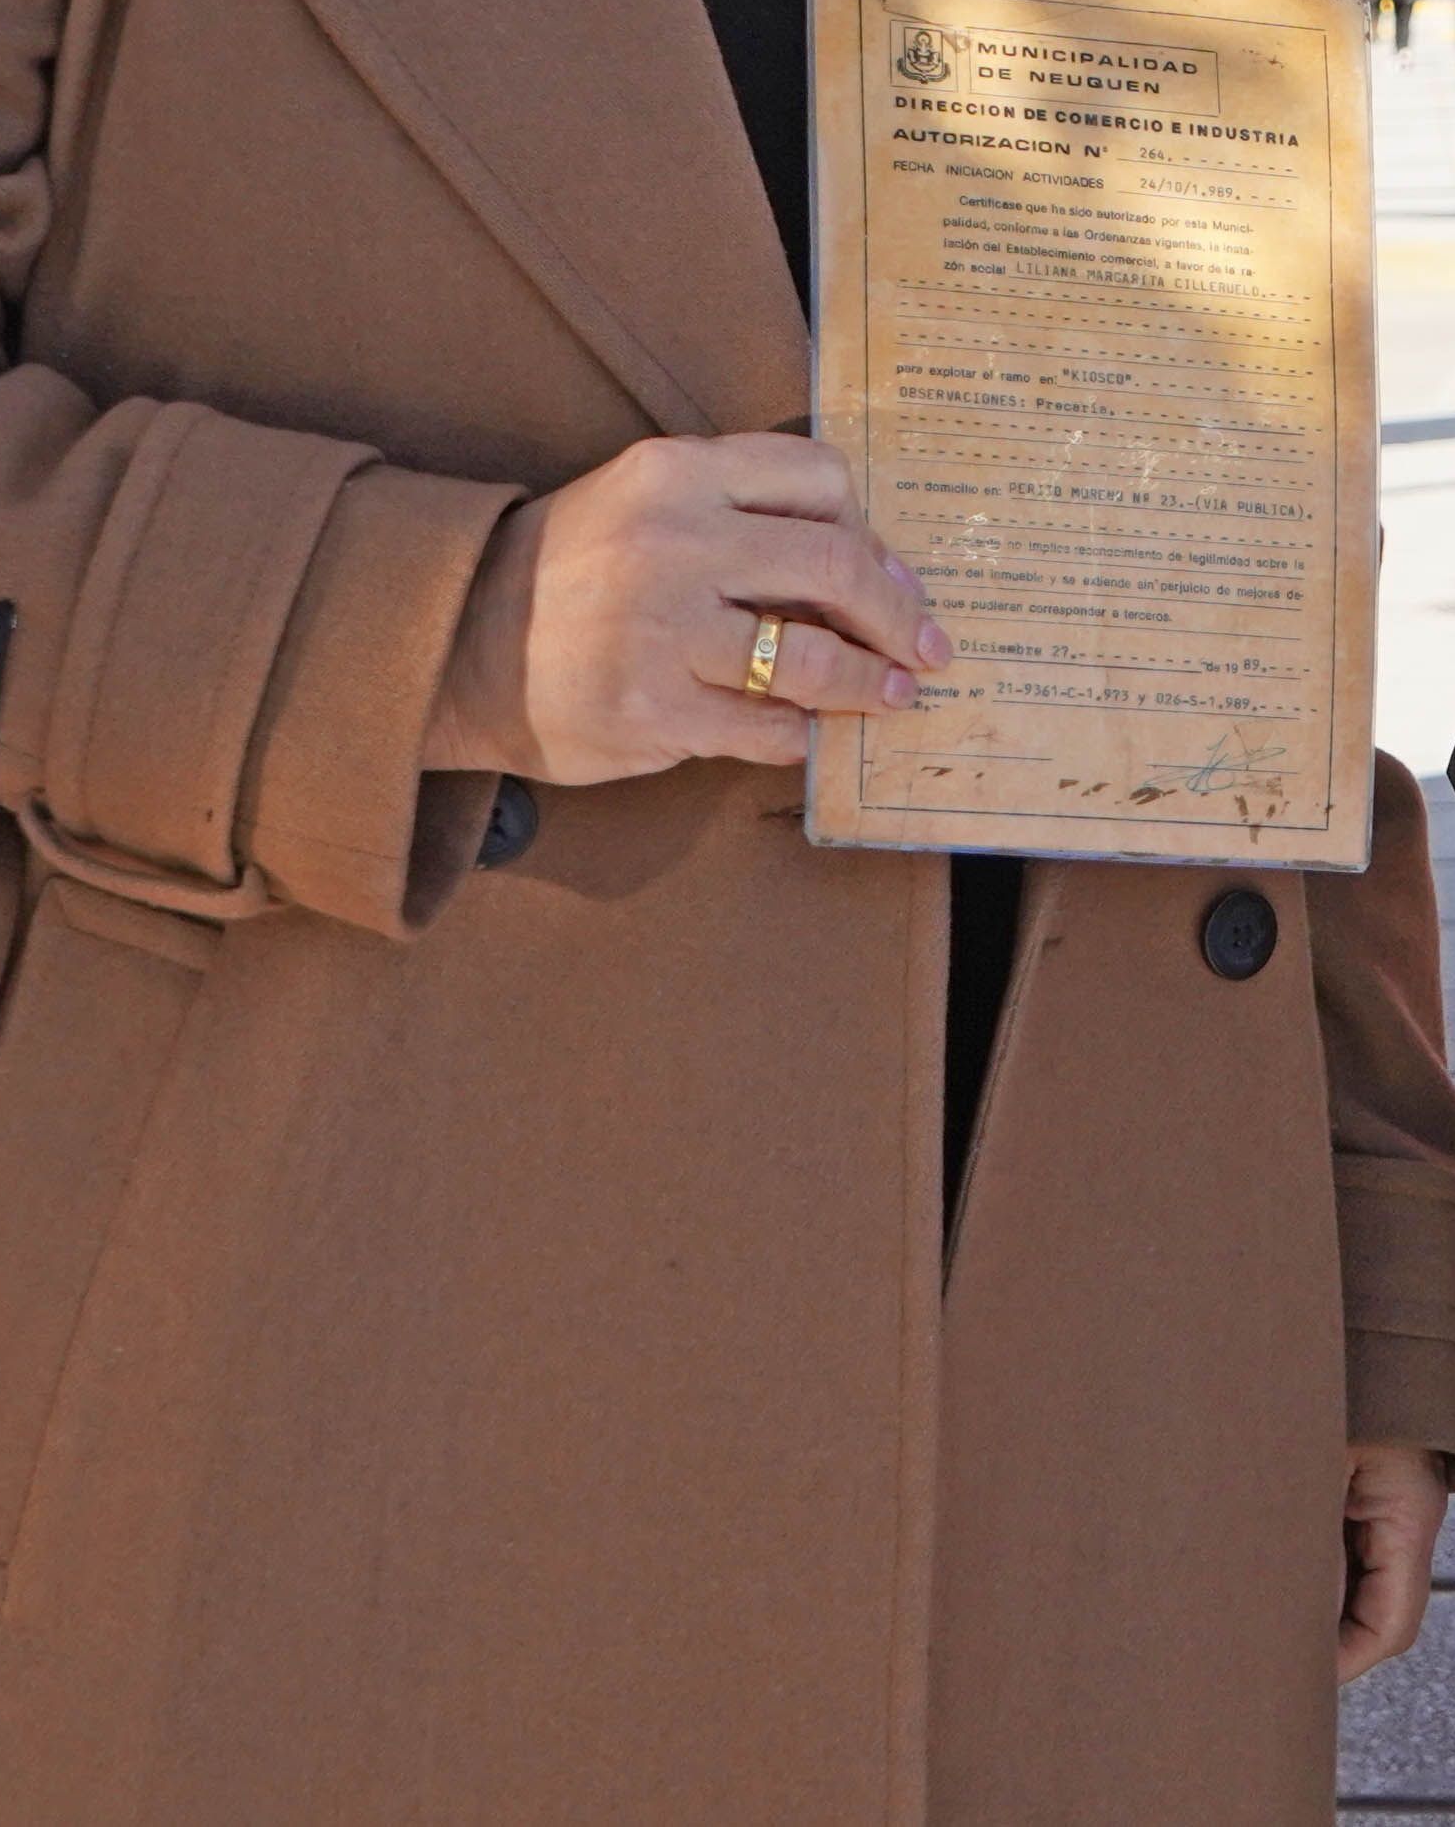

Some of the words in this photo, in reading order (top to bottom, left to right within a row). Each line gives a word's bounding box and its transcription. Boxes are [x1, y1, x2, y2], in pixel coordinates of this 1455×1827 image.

[978, 41, 1199, 75] MUNICIPALIDAD
[978, 66, 1013, 81] DE
[1029, 71, 1161, 94] NEUQUEN
[895, 96, 1016, 119] DIRECCION
[1024, 108, 1048, 122] DE
[1055, 110, 1164, 133] COMERCIO
[1171, 122, 1183, 134] E
[1189, 123, 1300, 148] INDUSTRIA
[893, 128, 1071, 156] AUTORIZACION
[893, 160, 935, 173] FECHA
[946, 165, 1014, 181] INICIACION
[1022, 172, 1104, 189] ACTIVIDADES
[1025, 202, 1048, 214] que
[1051, 204, 1066, 215] ha
[1069, 206, 1093, 218] sido
[1096, 208, 1156, 224] autorizado
[1161, 215, 1180, 228] por
[1185, 218, 1208, 230] esta
[1212, 219, 1254, 235] Munici-
[942, 217, 991, 231] palidad,
[994, 223, 1049, 237] conforme
[1052, 228, 1059, 237] a
[1062, 227, 1079, 239] las
[1083, 228, 1152, 246] Ordenanzas
[1154, 236, 1206, 252] vigentes,
[1209, 241, 1220, 252] la
[1222, 242, 1254, 256] insta-
[943, 238, 979, 251] lación
[983, 241, 1001, 253] del
[1006, 243, 1096, 262] Establecimiento
[1100, 253, 1160, 270] comercial,
[1164, 261, 1172, 269] a
[1176, 259, 1204, 272] favor
[1208, 262, 1222, 274] de
[1224, 264, 1236, 275] la
[1240, 267, 1256, 277] ra-
[943, 260, 965, 271] zón
[970, 263, 1006, 275] social
[1016, 261, 1077, 278] LILIANA
[1085, 269, 1165, 288] MARGARITA
[896, 364, 923, 375] para
[929, 365, 977, 380] explotar
[982, 369, 994, 381] el
[1000, 373, 1031, 384] ramo
[1039, 375, 1058, 386] en:
[899, 386, 1027, 409] OBSERVACIONES:
[896, 480, 920, 491] con
[924, 481, 979, 495] domicilio
[984, 485, 1002, 496] en:
[1009, 481, 1062, 497] PERITO
[1070, 487, 1124, 503] MORENO
[1237, 500, 1313, 521] PUBLICA).
[1007, 539, 1022, 550] no
[1028, 540, 1071, 555] implica
[1074, 545, 1163, 562] reconocimiento
[1168, 550, 1182, 562] de
[1188, 551, 1251, 567] legitimidad
[1256, 557, 1288, 570] sobre
[1293, 558, 1305, 570] la
[912, 564, 958, 581] upación
[965, 567, 984, 579] del
[990, 569, 1044, 583] inmueble
[1049, 575, 1057, 585] y
[1062, 574, 1076, 585] se
[1082, 575, 1131, 589] extiende
[1137, 578, 1154, 590] sin
[1160, 579, 1211, 596] perjuicio
[1216, 584, 1231, 595] de
[1237, 585, 1281, 600] mejores
[1286, 588, 1305, 601] de-
[942, 598, 965, 611] que
[970, 600, 1024, 615] pudieran
[1029, 603, 1106, 619] corresponder
[1112, 610, 1120, 619] a
[1123, 608, 1172, 622] terceros.
[959, 639, 1042, 657] Diciembre
[1205, 661, 1221, 673] de
[1225, 662, 1239, 674] 19
[1137, 694, 1146, 705] y
